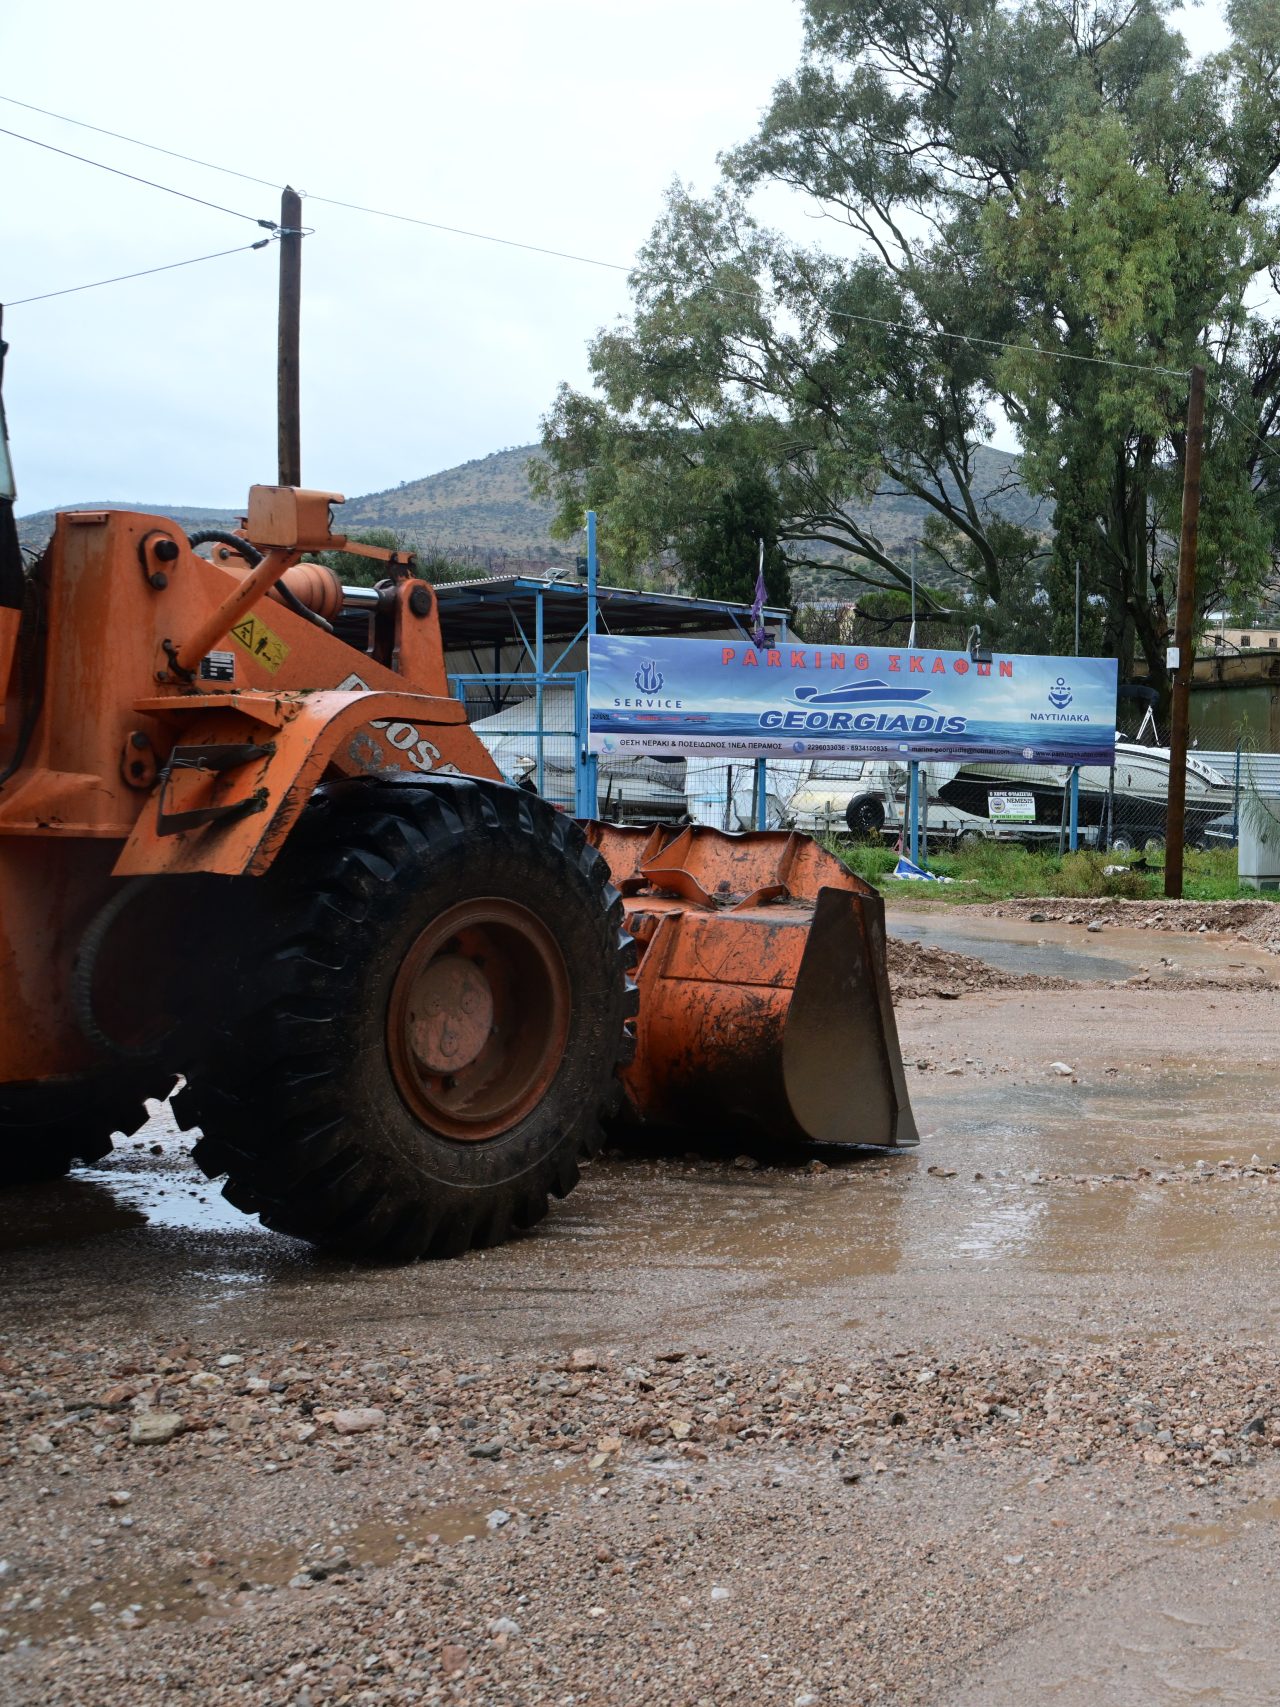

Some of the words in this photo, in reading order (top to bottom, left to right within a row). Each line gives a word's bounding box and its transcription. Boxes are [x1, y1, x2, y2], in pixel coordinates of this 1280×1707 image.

[722, 648, 869, 670] PARKING
[888, 655, 1013, 677] ΣΚΑΦΩΝ
[614, 698, 682, 709] SERVICE
[758, 710, 968, 735] GEORGIADIS
[1030, 713, 1090, 722] ΝΑΥΤΙΛΙΑΚΑ
